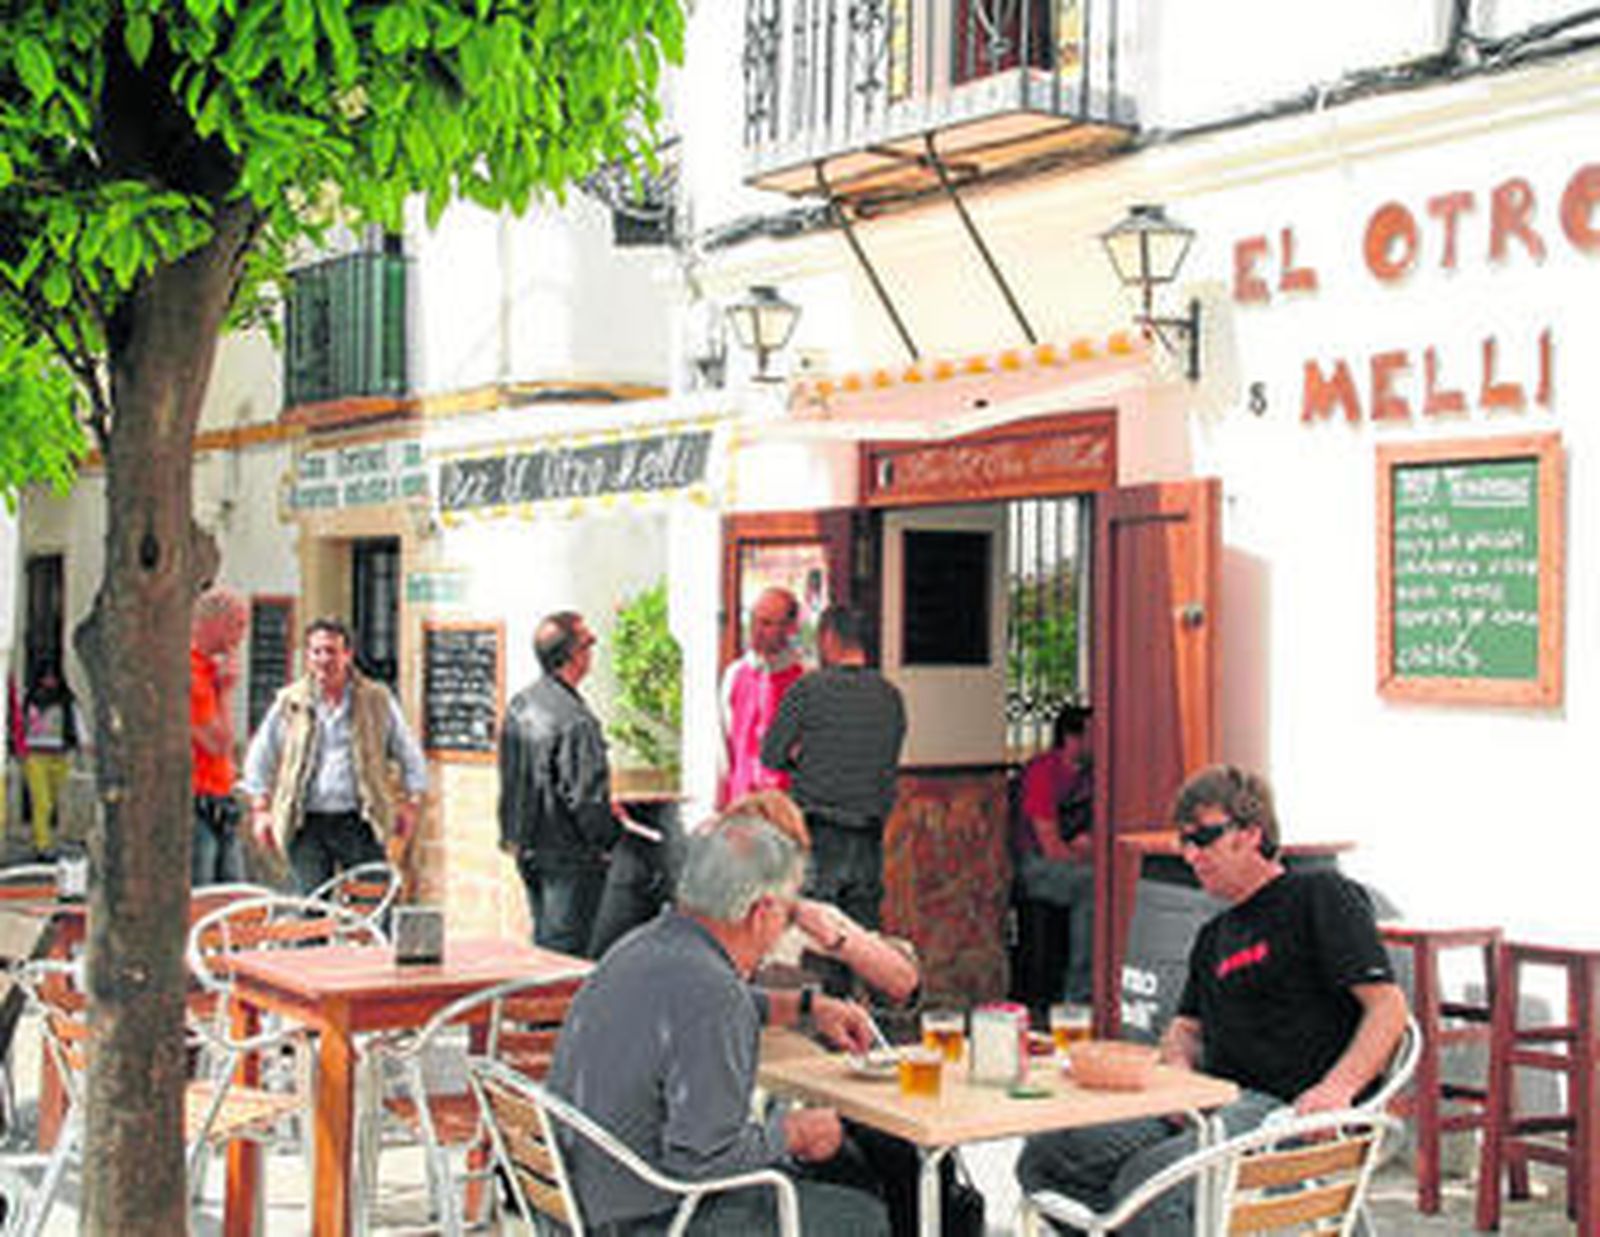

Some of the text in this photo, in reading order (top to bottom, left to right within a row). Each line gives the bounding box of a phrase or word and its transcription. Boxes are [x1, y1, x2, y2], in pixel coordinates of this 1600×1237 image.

[1233, 163, 1600, 303] EL OTRO
[1299, 328, 1552, 426] MELLI
